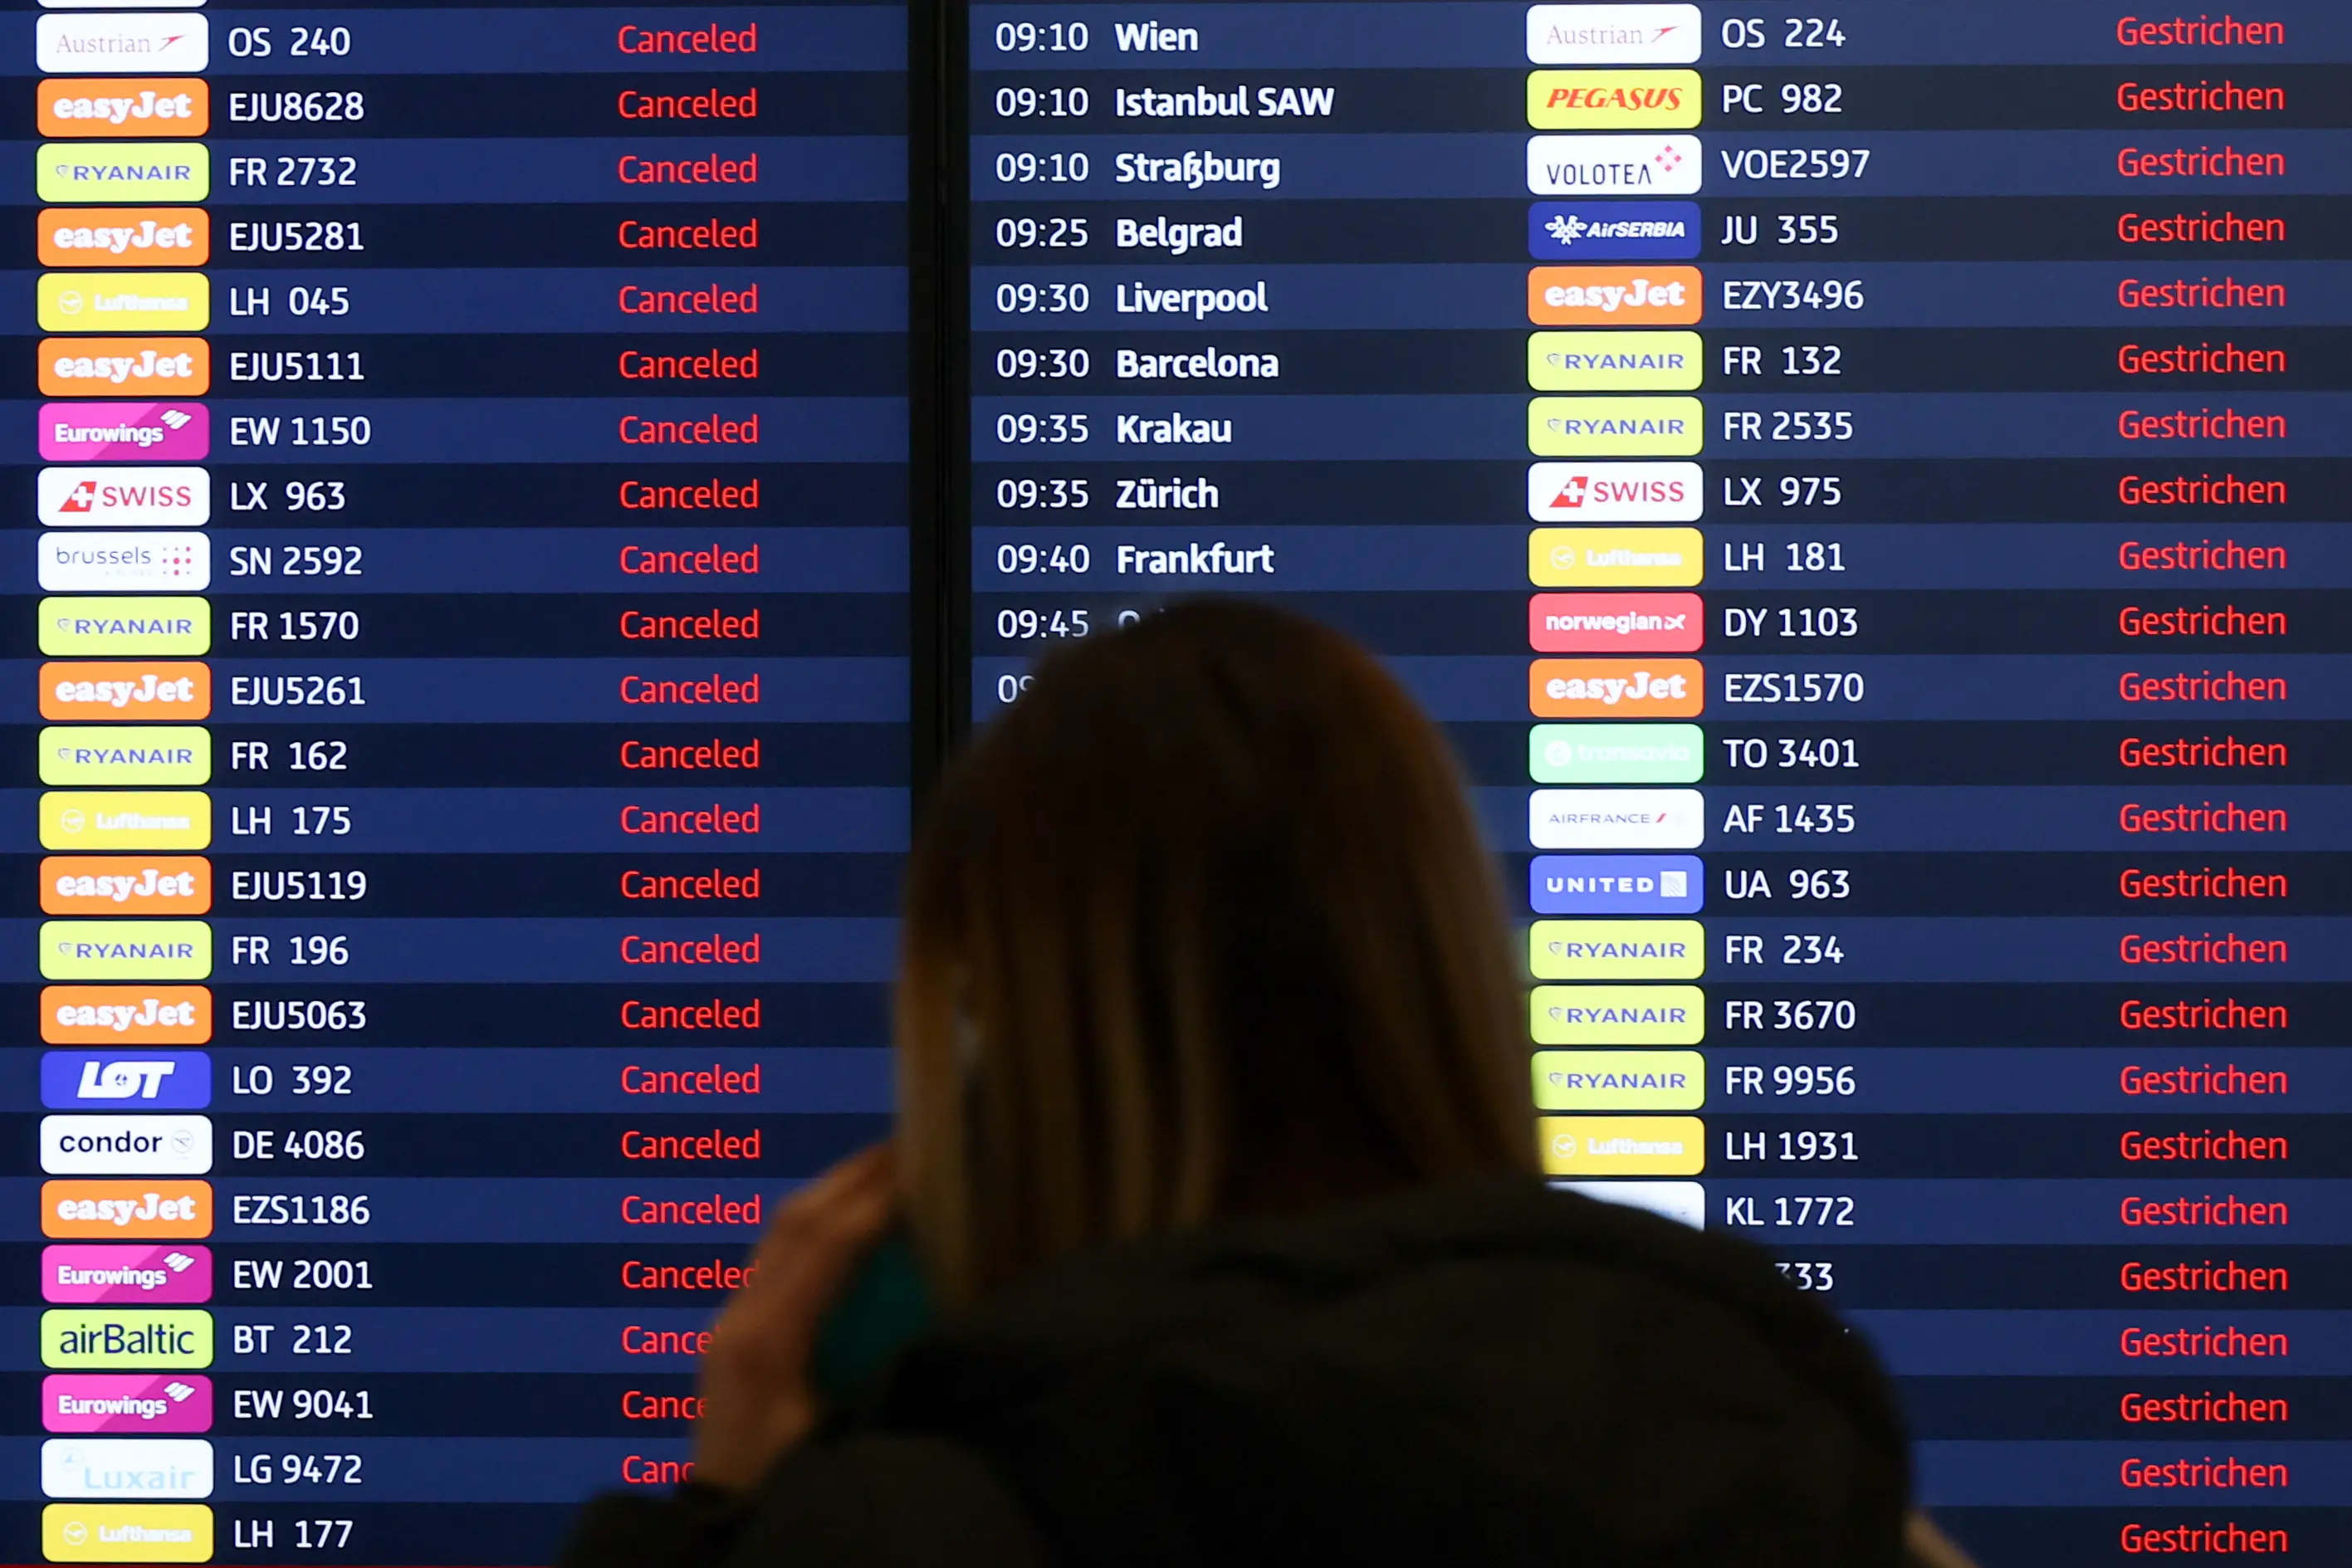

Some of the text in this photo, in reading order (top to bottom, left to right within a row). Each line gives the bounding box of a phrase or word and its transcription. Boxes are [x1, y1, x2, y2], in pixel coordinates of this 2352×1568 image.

[56, 35, 150, 52] Austrian
[229, 27, 350, 56] OS 240
[619, 23, 757, 53] Canceled
[996, 22, 1088, 51] 09:10
[1115, 21, 1197, 51] Wien
[1548, 26, 1642, 44] Austrian
[1723, 19, 1846, 47] OS 224
[2117, 15, 2284, 46] Gestrichen
[53, 91, 193, 123] easyJet
[231, 92, 364, 121] EJU8628
[996, 88, 1088, 116] 09:10
[1117, 85, 1334, 116] Istanbul SAW
[1547, 88, 1682, 110] PEGASUS
[1724, 84, 1841, 113] PC 982
[75, 165, 190, 180] RYANAIR
[231, 158, 355, 185] FR 2732
[619, 154, 757, 183] Canceled
[997, 154, 1088, 182] 09:10
[1116, 151, 1279, 188] Straßburg
[1721, 149, 1870, 178] VOE2597
[2118, 146, 2285, 176] Gestrichen
[231, 222, 364, 251] EJU5281
[997, 218, 1088, 247] 09:25
[1117, 217, 1242, 255] Belgrad
[1722, 216, 1837, 244] JU 355
[231, 287, 349, 315] LH 045
[619, 284, 758, 313] Canceled
[997, 284, 1088, 312] 09:30
[1117, 281, 1268, 320] Liverpool
[1724, 281, 1863, 309] EZY3496
[2119, 277, 2285, 307] Gestrichen
[54, 350, 193, 383] easyJet
[232, 353, 364, 380] EJU5111
[997, 349, 1088, 378] 09:30
[1117, 347, 1278, 378] Barcelona
[1565, 354, 1684, 369] RYANAIR
[1724, 346, 1840, 374] FR 132
[56, 423, 164, 447] Eurowings
[232, 417, 370, 445] EW 1150
[619, 414, 759, 443] Canceled
[998, 415, 1088, 442] 09:35
[1117, 413, 1231, 442] Krakau
[1725, 412, 1852, 440] FR 2535
[2119, 408, 2286, 439] Gestrichen
[103, 486, 191, 506] SWISS
[232, 481, 345, 510] LX 963
[998, 480, 1088, 508] 09:35
[1117, 478, 1218, 508] Zürich
[1594, 481, 1684, 502] SWISS
[1725, 477, 1841, 506] LX 975
[57, 547, 150, 564] brussels
[231, 547, 361, 575] SN 2592
[620, 544, 759, 574] Canceled
[998, 545, 1089, 573] 09:40
[1118, 542, 1274, 574] Frankfurt
[1725, 543, 1845, 570] LH 181
[2120, 540, 2286, 570] Gestrichen
[232, 612, 358, 639] FR 1570
[998, 610, 1088, 638] 09:45
[1546, 612, 1661, 634] norwegian
[1726, 608, 1857, 636] DY 1103
[232, 677, 365, 705] EJU5261
[1546, 672, 1686, 704] easyJet
[1726, 673, 1863, 702] EZS1570
[76, 749, 192, 763] RYANAIR
[232, 741, 346, 769] FR 162
[1723, 739, 1859, 767] TO 3401
[232, 807, 350, 834] LH 175
[621, 804, 760, 833] Canceled
[1724, 805, 1854, 832] AF 1435
[2120, 802, 2287, 832] Gestrichen
[56, 869, 195, 901] easyJet
[233, 872, 365, 900] EJU5119
[1548, 877, 1654, 892] UNITED
[1726, 870, 1849, 898] UA 963
[233, 936, 348, 965] FR 196
[621, 934, 760, 964] Canceled
[1567, 942, 1685, 957] RYANAIR
[1727, 935, 1844, 963] FR 234
[2120, 933, 2287, 963] Gestrichen
[233, 1001, 365, 1029] EJU5063
[1727, 1001, 1855, 1029] FR 3670
[77, 1062, 174, 1098] LOT
[234, 1066, 350, 1094] LO 392
[622, 1064, 760, 1094] Canceled
[1567, 1073, 1685, 1088] RYANAIR
[1727, 1066, 1855, 1095] FR 9956
[2121, 1064, 2287, 1095] Gestrichen
[60, 1131, 162, 1152] condor
[234, 1131, 364, 1159] DE 4086
[1727, 1131, 1858, 1160] LH 1931
[57, 1193, 196, 1225] easyJet
[234, 1195, 369, 1224] EZS1186
[622, 1194, 760, 1224] Canceled
[1727, 1197, 1853, 1225] KL 1772
[2121, 1195, 2288, 1225] Gestrichen
[59, 1265, 167, 1290] Eurowings
[234, 1260, 372, 1288] EW 2001
[61, 1324, 193, 1354] airBaltic
[235, 1326, 351, 1353] BT 212
[2121, 1326, 2288, 1356] Gestrichen
[59, 1395, 168, 1420] Eurowings
[235, 1390, 373, 1419] EW 9041
[85, 1466, 195, 1489] Luxair
[235, 1455, 361, 1483] LG 9472
[2121, 1457, 2288, 1487] Gestrichen
[235, 1520, 353, 1547] LH 177
